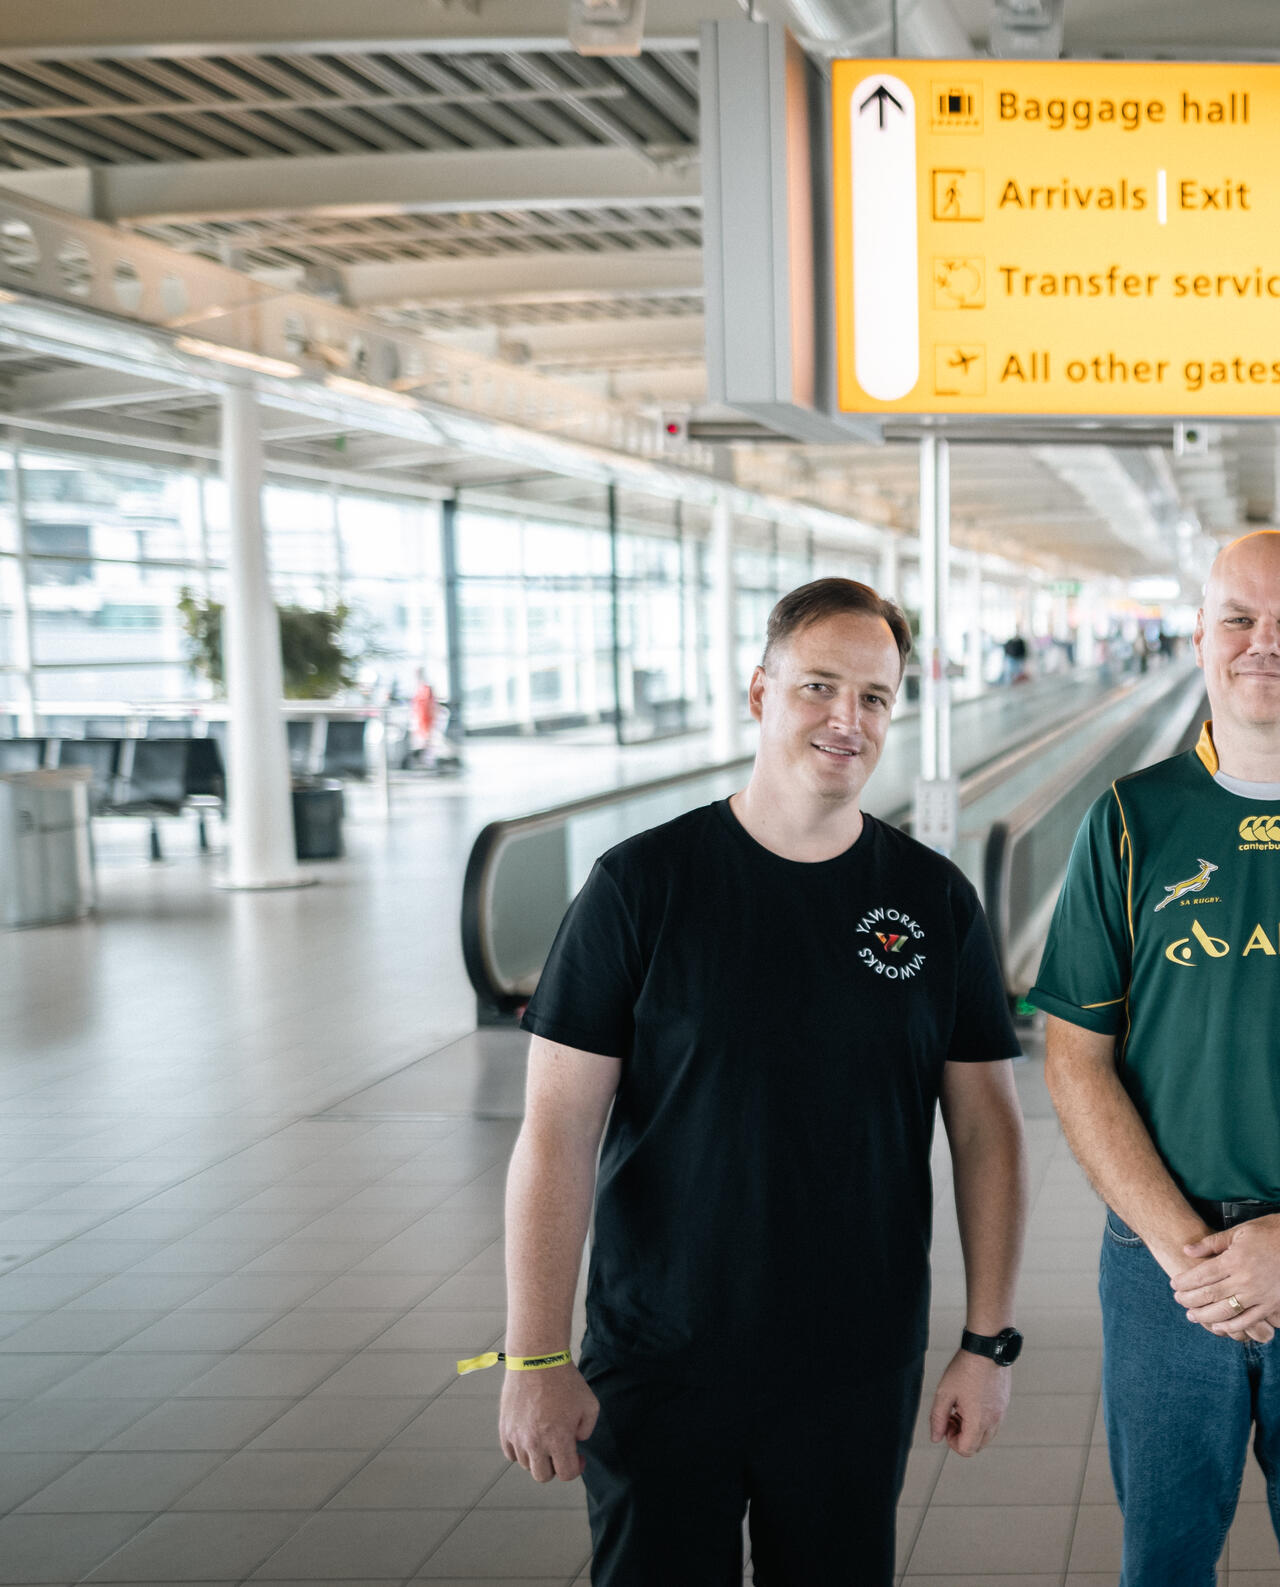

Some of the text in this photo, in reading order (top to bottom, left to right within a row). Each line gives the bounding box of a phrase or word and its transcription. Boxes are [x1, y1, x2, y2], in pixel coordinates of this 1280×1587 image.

[998, 91, 1250, 131] Baggage hall
[999, 179, 1250, 211] Arrivals Exit
[999, 265, 1159, 298] Transfer
[1000, 351, 1050, 384] All
[1066, 353, 1169, 384] other
[856, 907, 925, 939] YAWORKS
[858, 947, 926, 980] YAWORKS
